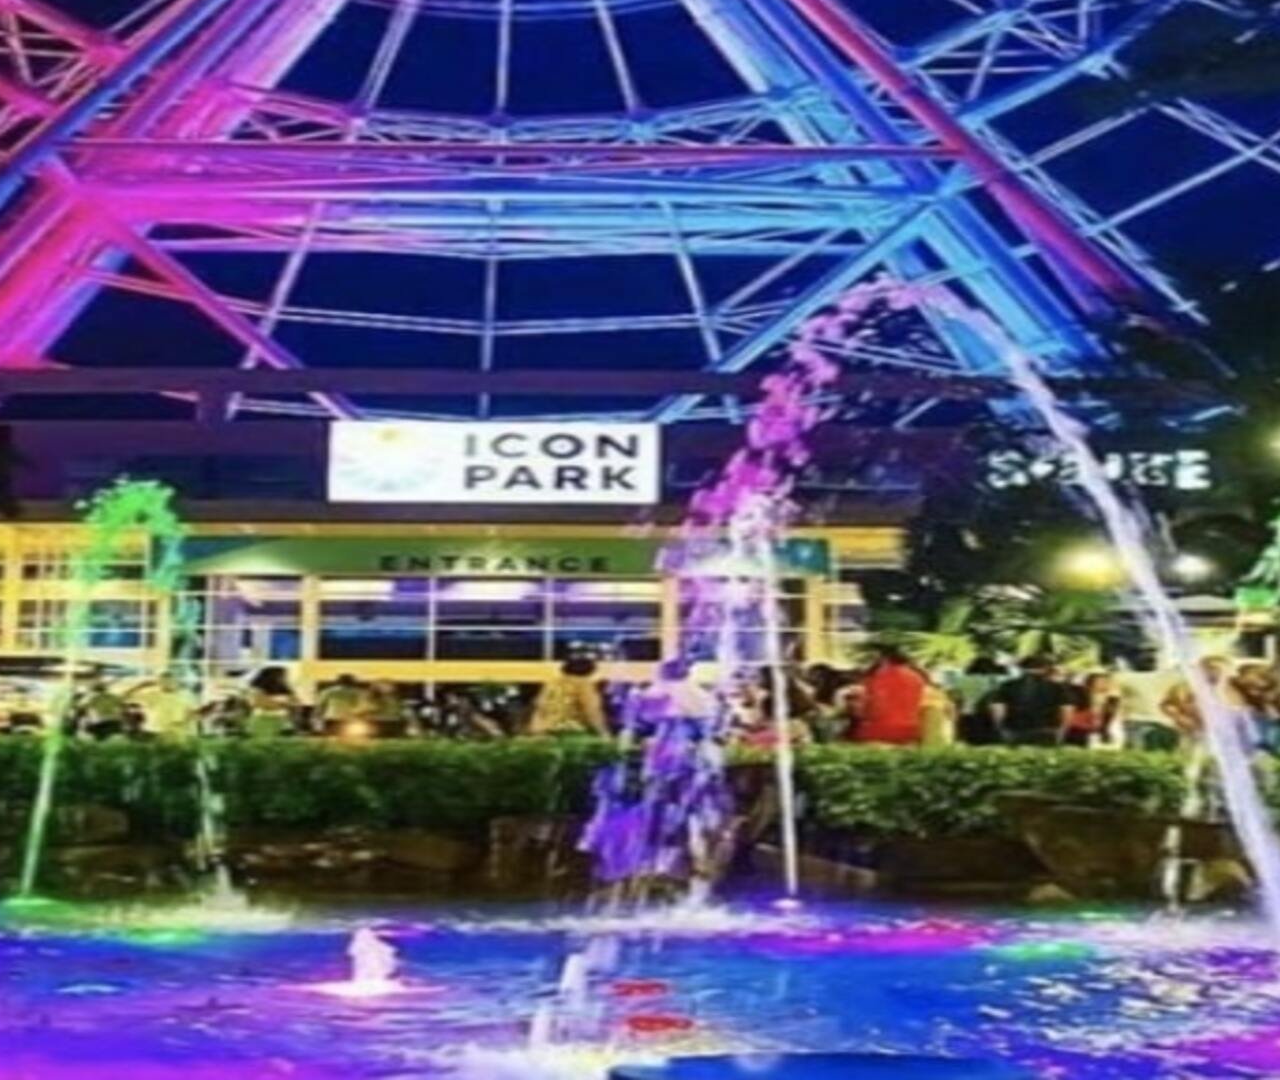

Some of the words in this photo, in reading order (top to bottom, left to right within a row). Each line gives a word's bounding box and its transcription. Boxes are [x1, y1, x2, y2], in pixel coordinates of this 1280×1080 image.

[464, 433, 638, 459] ICON
[464, 465, 636, 490] PARK
[379, 555, 610, 572] ENTRANCE
